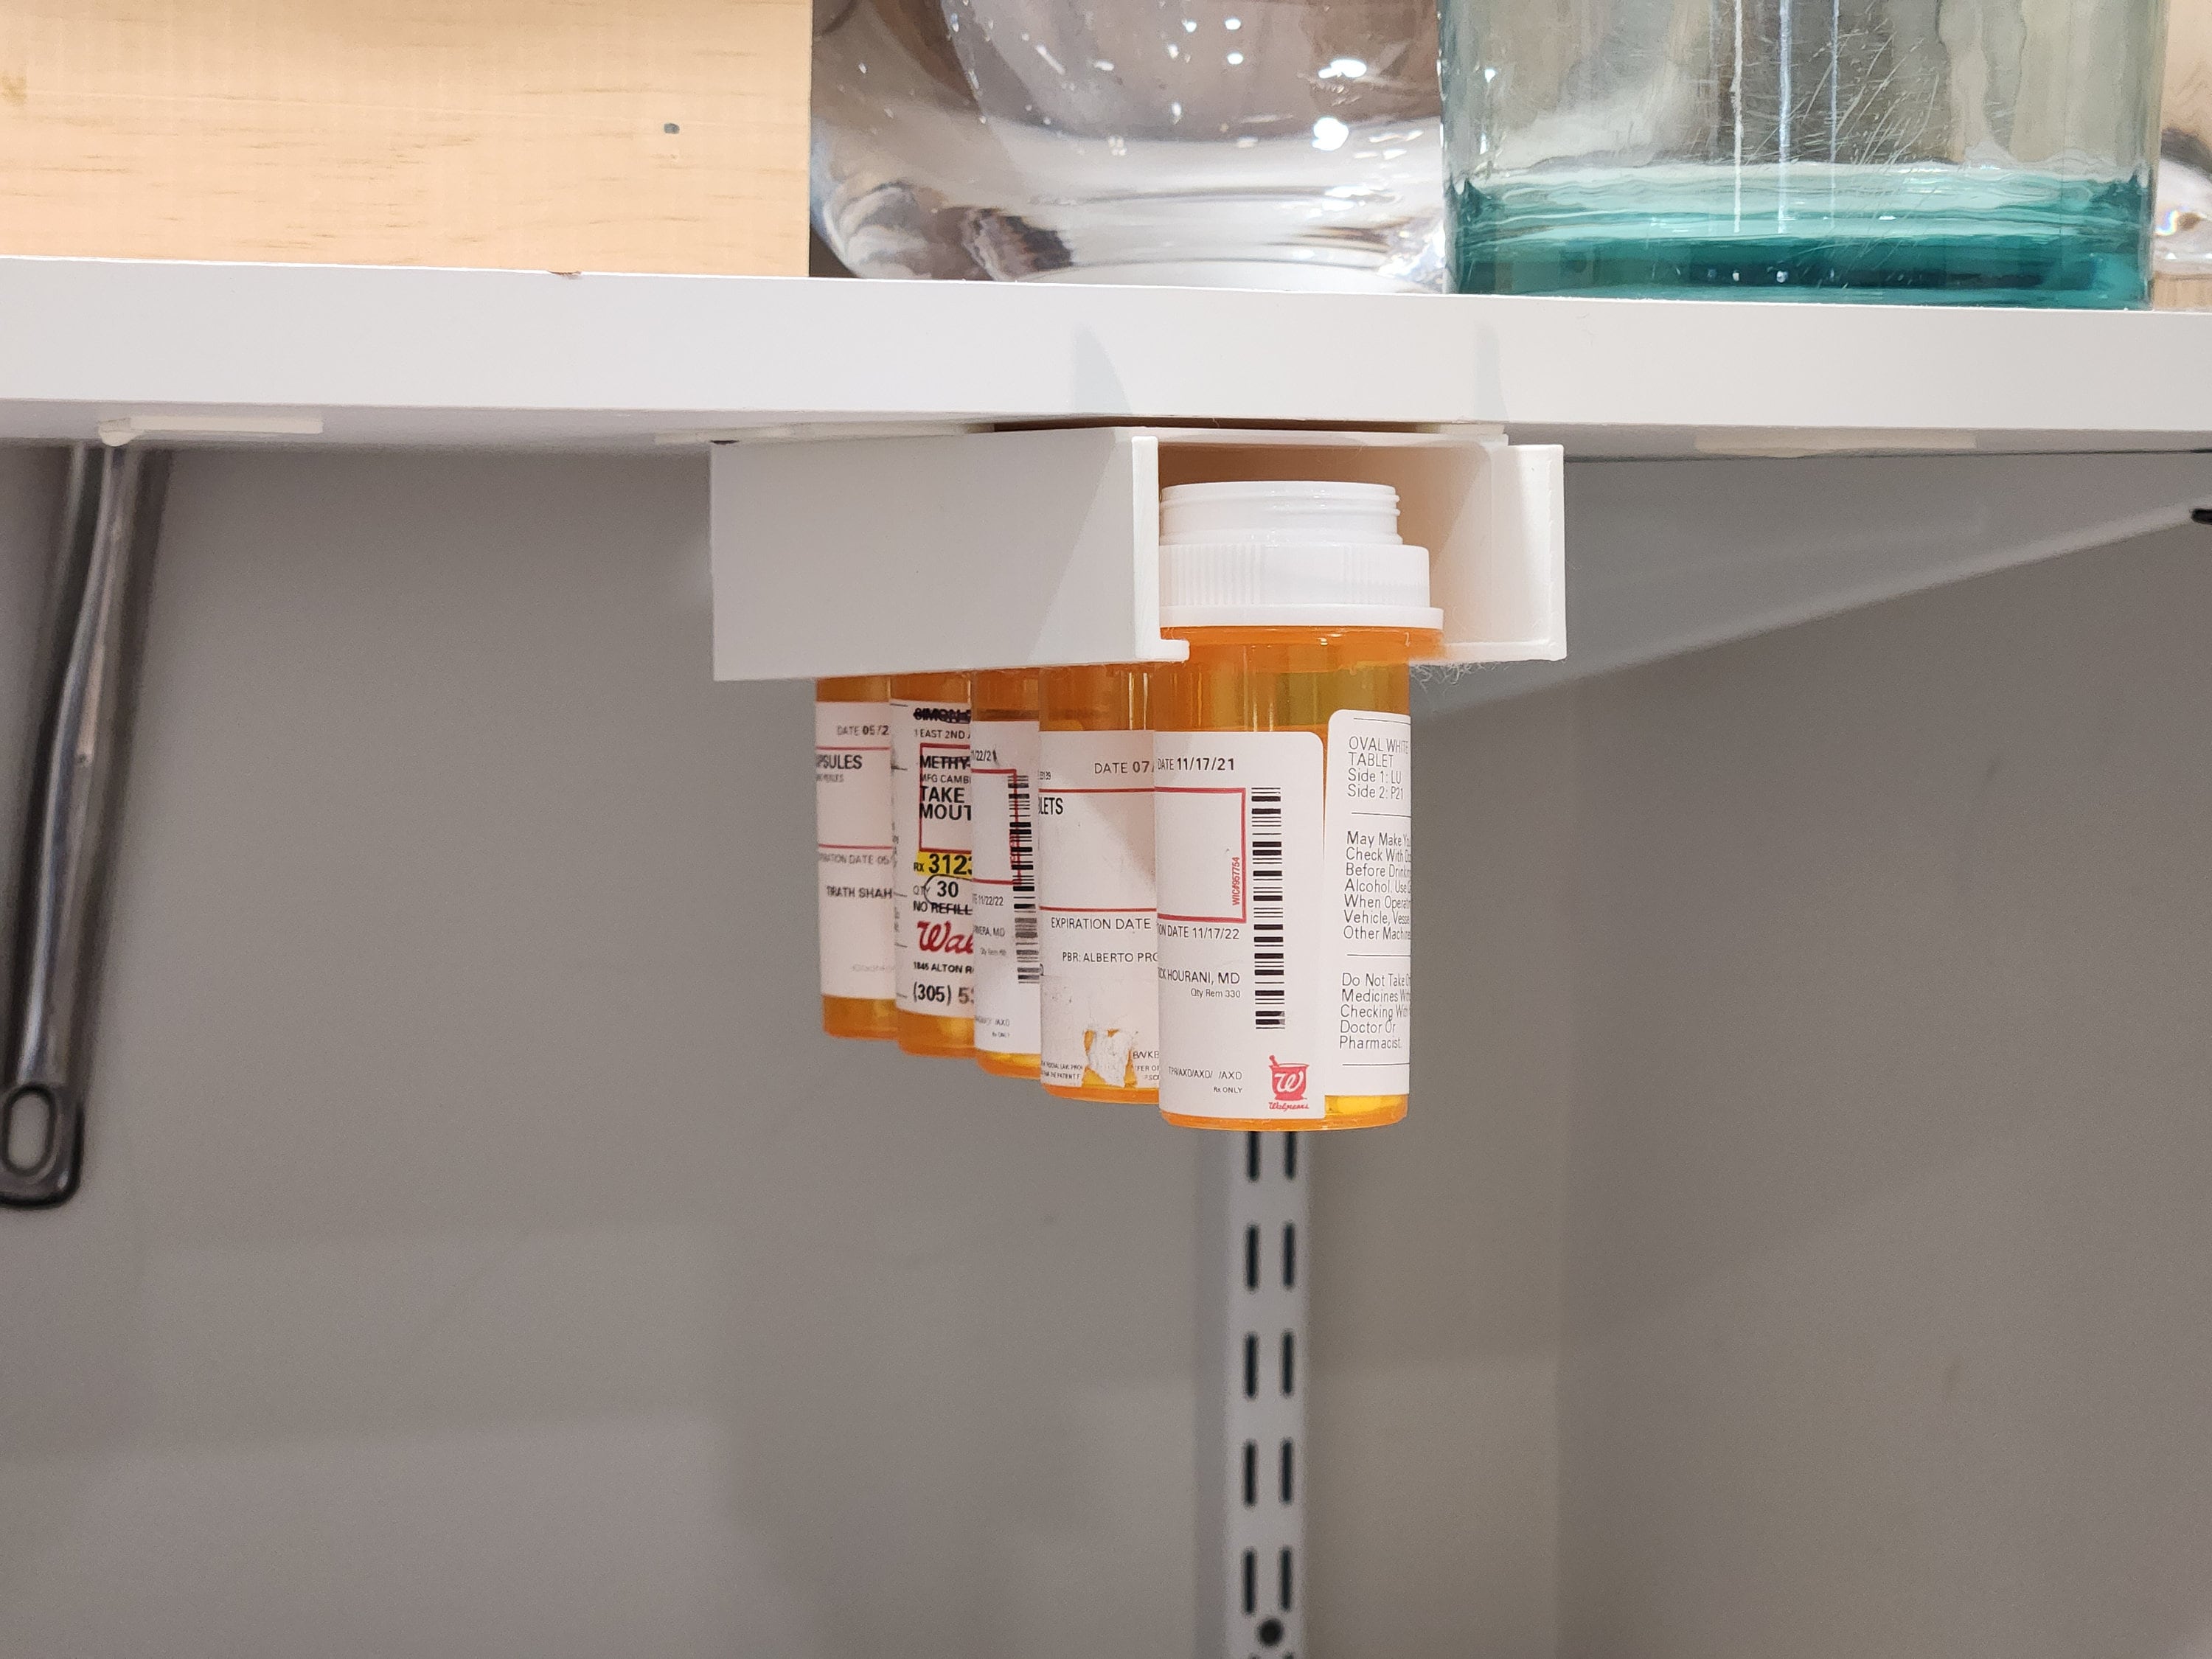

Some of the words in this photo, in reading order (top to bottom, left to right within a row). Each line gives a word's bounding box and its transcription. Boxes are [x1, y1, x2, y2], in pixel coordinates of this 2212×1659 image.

[837, 725, 860, 736] DATE
[919, 728, 942, 738] EAST
[945, 730, 965, 740] 2ND
[1349, 736, 1384, 752] OVAL
[920, 754, 971, 770] METHY
[1158, 758, 1174, 771] DATE
[1177, 757, 1235, 771] 11/17/21
[1348, 751, 1394, 768] TABLET
[1094, 762, 1128, 774] DATE
[940, 774, 971, 785] CAMB
[1348, 768, 1376, 782] Side
[1380, 770, 1388, 783] 1:
[1391, 771, 1402, 785] LU
[920, 785, 964, 804] TAKE
[1348, 783, 1376, 798] Side
[1379, 785, 1388, 799] 2:
[1346, 830, 1375, 848] May
[1379, 832, 1402, 846] Make
[849, 855, 874, 865] DATE
[1346, 846, 1382, 861] Check
[1385, 848, 1404, 862] With
[1346, 862, 1385, 877] Before
[859, 887, 892, 899] SHAH
[937, 880, 959, 898] 30
[1344, 878, 1393, 893] Alcohol.
[1394, 880, 1407, 894] Use
[914, 900, 928, 912] NO
[1344, 893, 1381, 908] When
[1051, 917, 1111, 930] EXPIRATION
[1116, 918, 1151, 930] DATE
[1343, 909, 1391, 926] Vehicle,
[1168, 925, 1189, 938] DATE
[1192, 927, 1239, 940] 11/17/22
[1343, 925, 1380, 939] Other
[1062, 951, 1081, 963] PBR:
[1083, 953, 1134, 963] ALBERTO
[931, 963, 962, 973] ALTON
[964, 966, 974, 974] R
[1167, 969, 1214, 986] HOURANI,
[1217, 972, 1240, 984] MD
[1342, 972, 1360, 987] Do
[1366, 973, 1385, 987] Not
[1388, 973, 1405, 987] Take
[913, 981, 952, 1006] (305)
[1190, 988, 1203, 998] Qty
[1206, 988, 1222, 997] Rem
[1225, 990, 1241, 998] 330
[1342, 988, 1398, 1002] Medicines
[1340, 1004, 1394, 1022] Checking
[1340, 1019, 1382, 1033] Doctor
[1385, 1019, 1397, 1033] Or
[1339, 1034, 1402, 1048] Pharmacist.
[1218, 1071, 1242, 1080] /AXD
[1274, 1070, 1304, 1094] W
[1268, 1102, 1310, 1112] Walgreens
